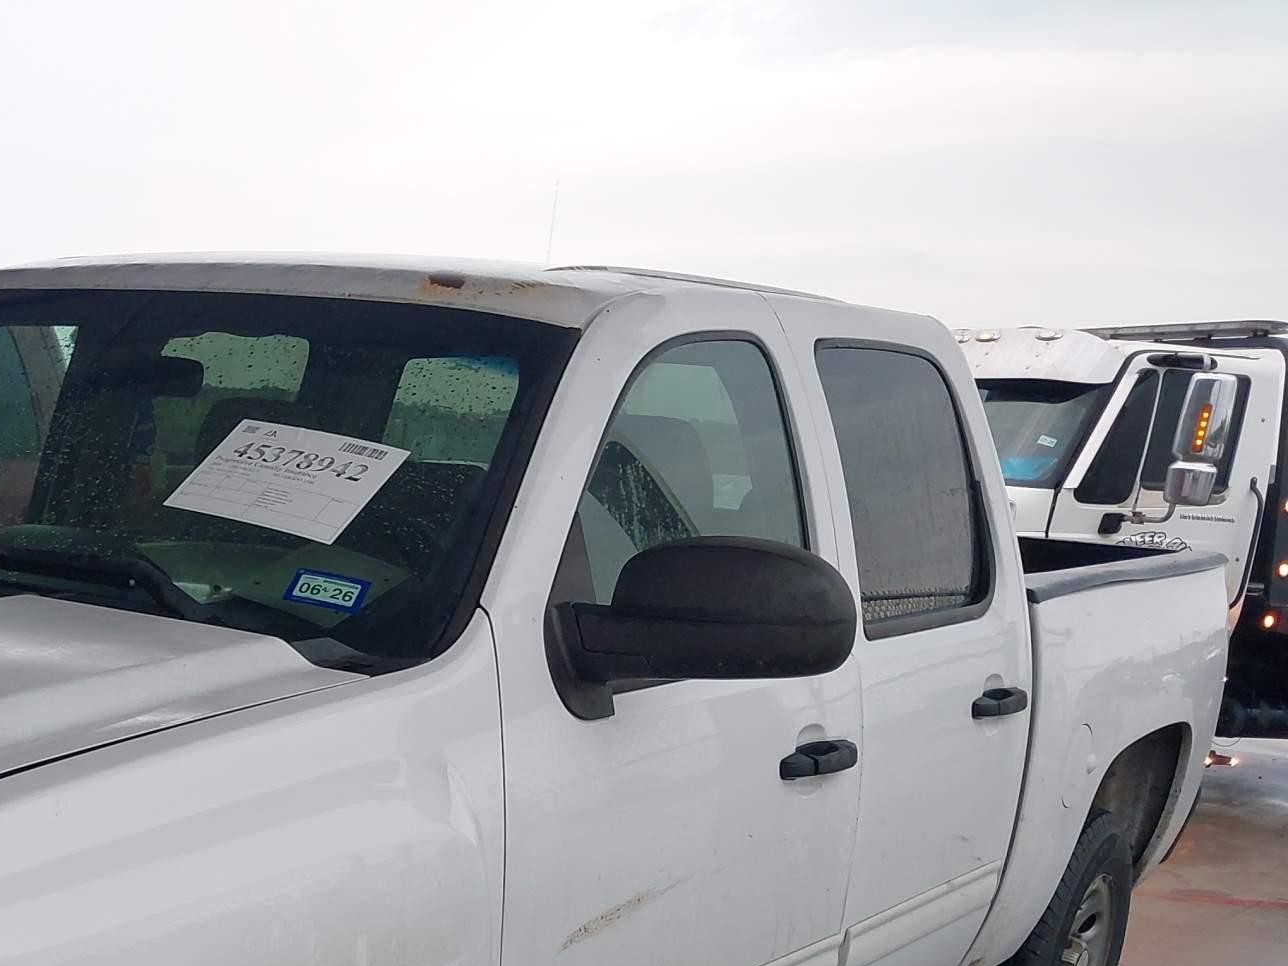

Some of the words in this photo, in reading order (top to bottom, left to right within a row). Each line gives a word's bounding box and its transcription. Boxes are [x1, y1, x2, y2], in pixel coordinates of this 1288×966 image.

[232, 442, 369, 482] 45378942
[298, 582, 323, 596] 06
[329, 587, 354, 602] 26
